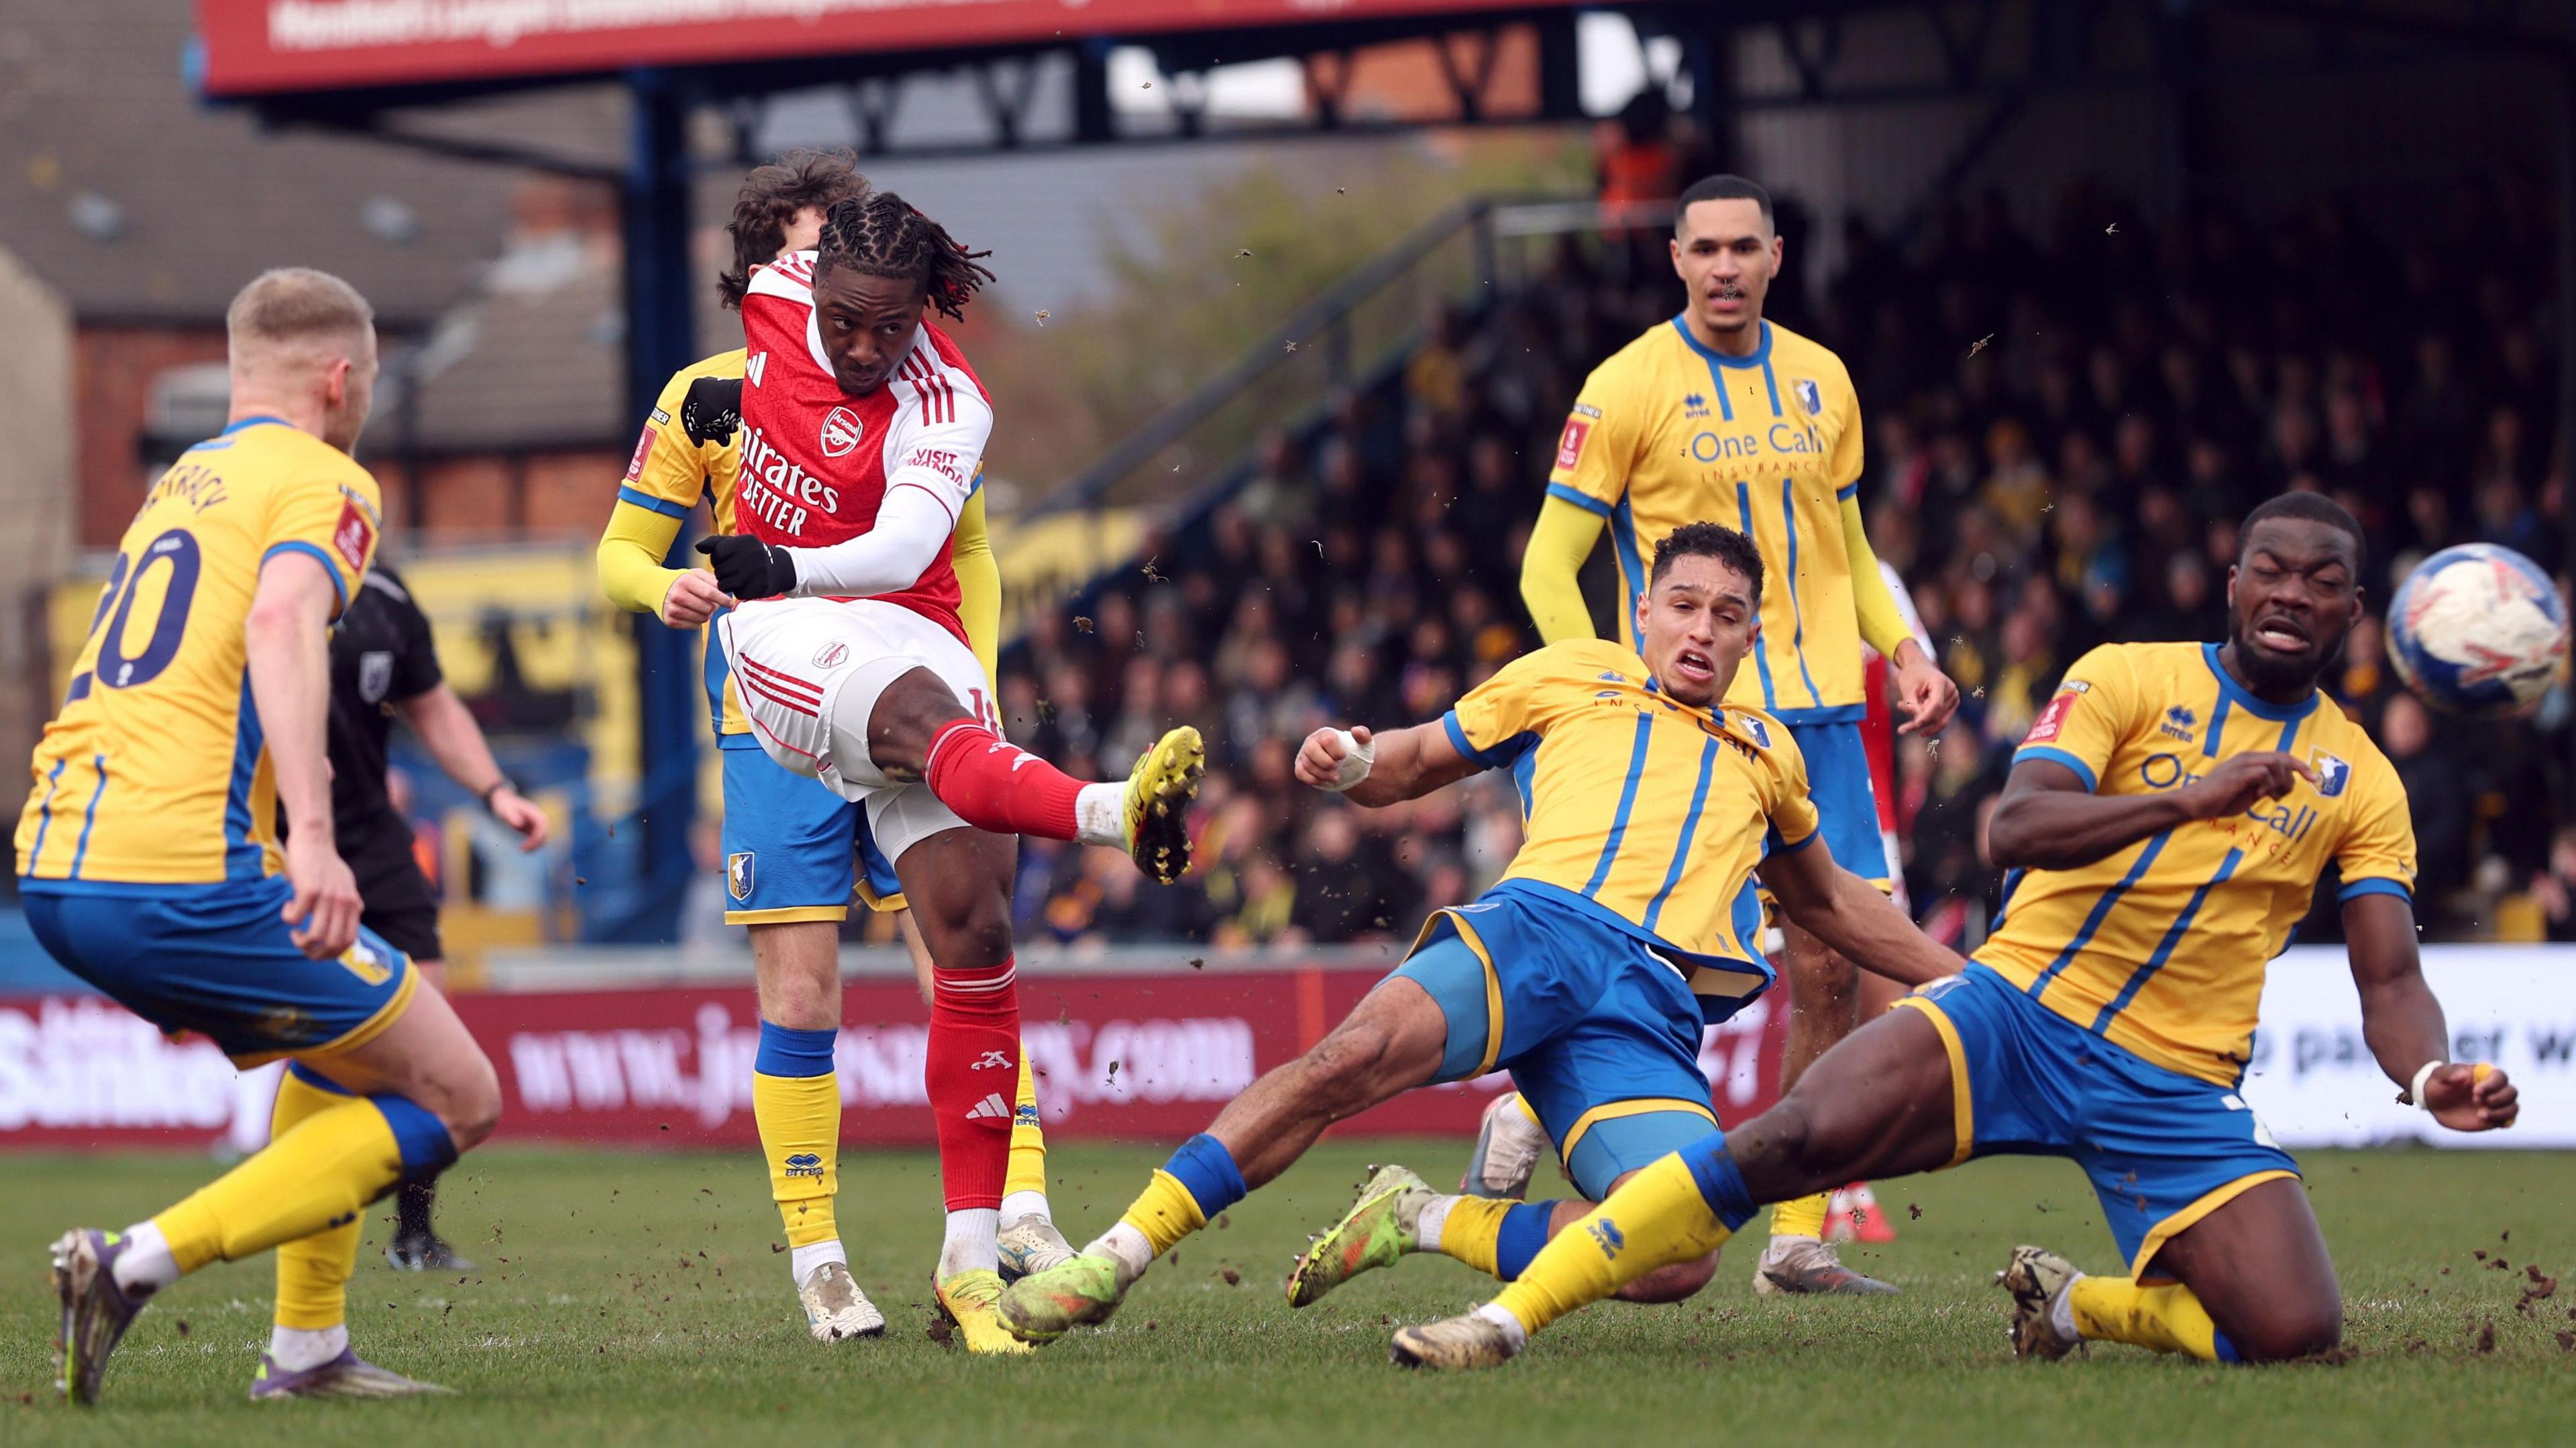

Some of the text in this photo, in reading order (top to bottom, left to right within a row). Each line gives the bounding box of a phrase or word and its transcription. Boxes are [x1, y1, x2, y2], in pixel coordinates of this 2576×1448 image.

[833, 414, 859, 435] Arsenal
[916, 448, 958, 465] VISIT
[1693, 423, 1823, 462] One Call
[741, 471, 808, 537] BETTER
